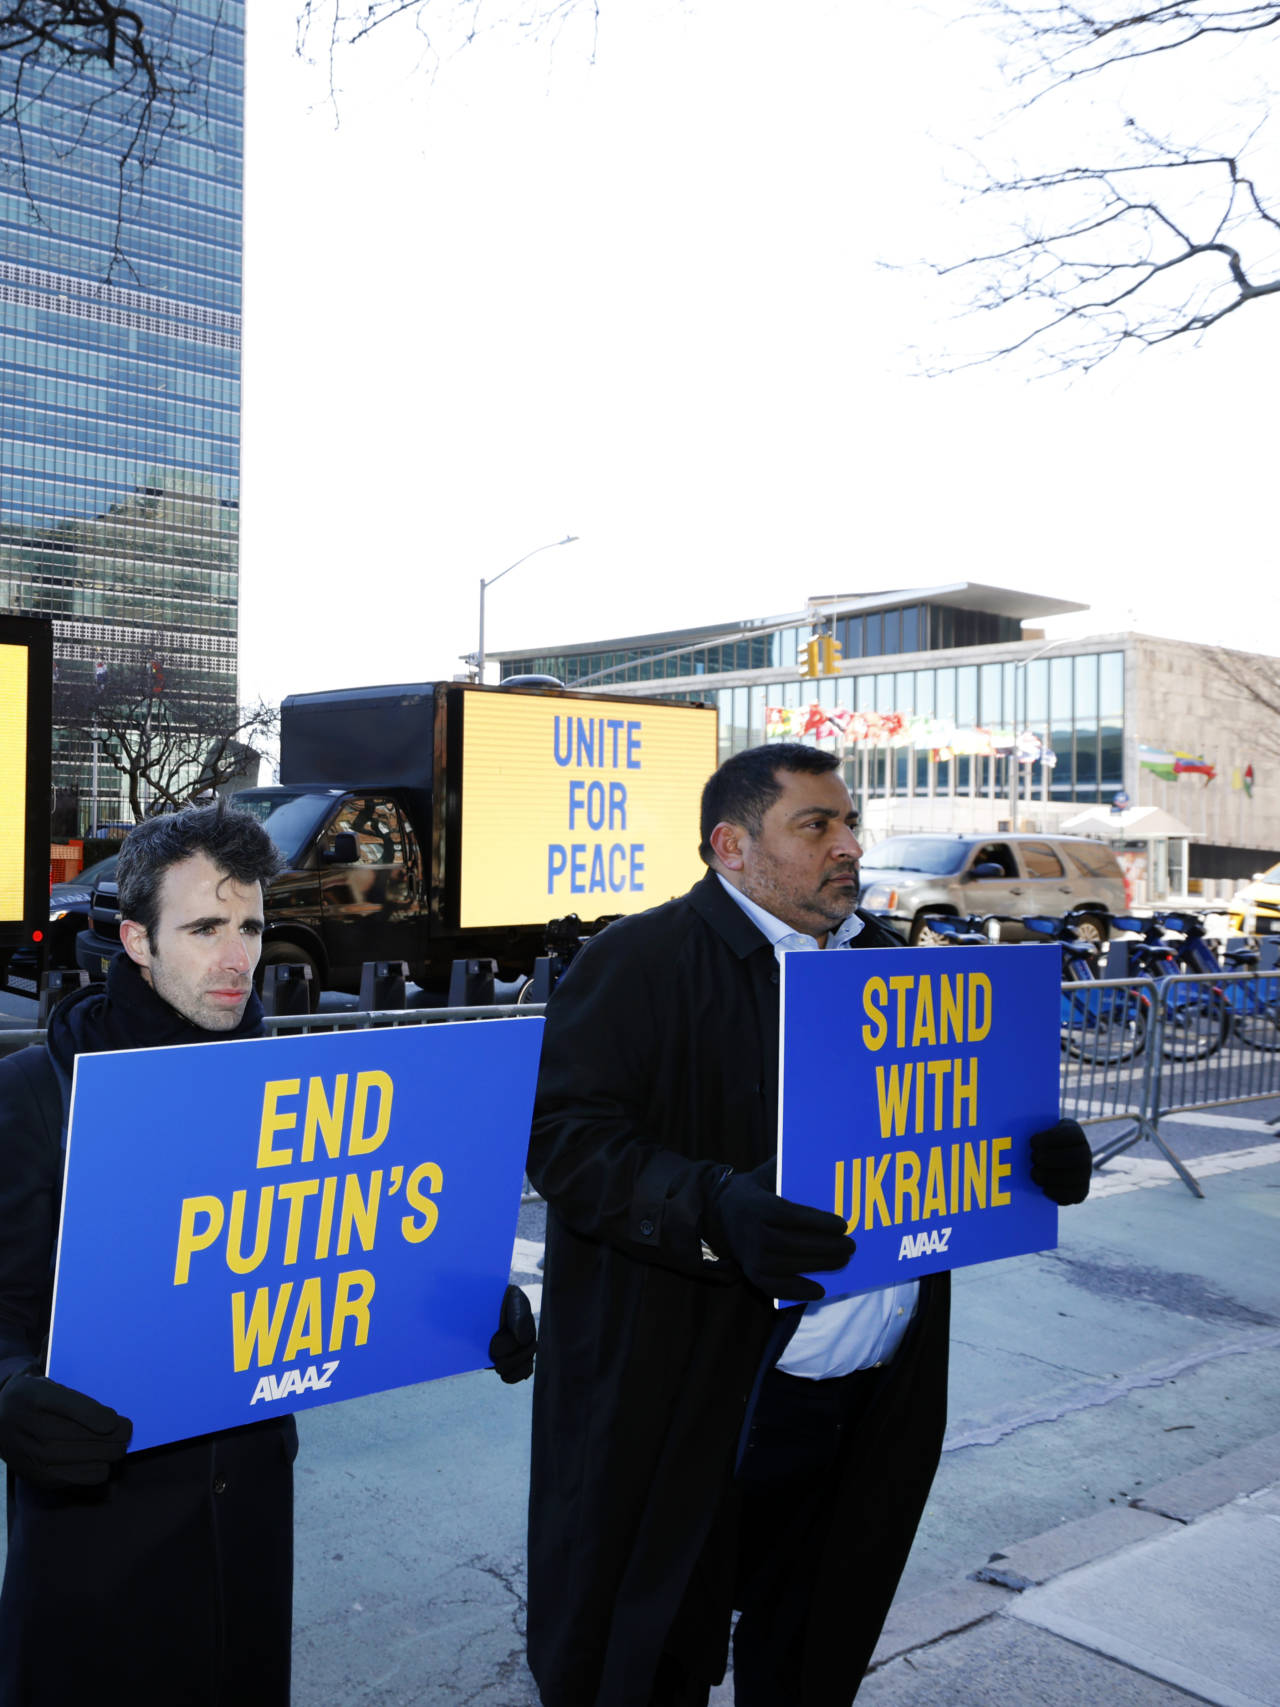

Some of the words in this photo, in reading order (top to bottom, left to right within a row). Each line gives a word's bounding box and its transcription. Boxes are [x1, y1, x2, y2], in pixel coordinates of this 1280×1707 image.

[554, 715, 642, 770] UNITE
[569, 780, 628, 832] FOR
[548, 843, 645, 895] PEACE
[862, 972, 993, 1051] STAND
[256, 1070, 394, 1169] END
[875, 1057, 978, 1139] WITH
[173, 1162, 444, 1286] PUTIN’S
[834, 1136, 1012, 1236] UKRAINE
[898, 1227, 952, 1261] AVAAZ
[231, 1269, 376, 1373] WAR
[250, 1360, 340, 1405] AVAAZ
